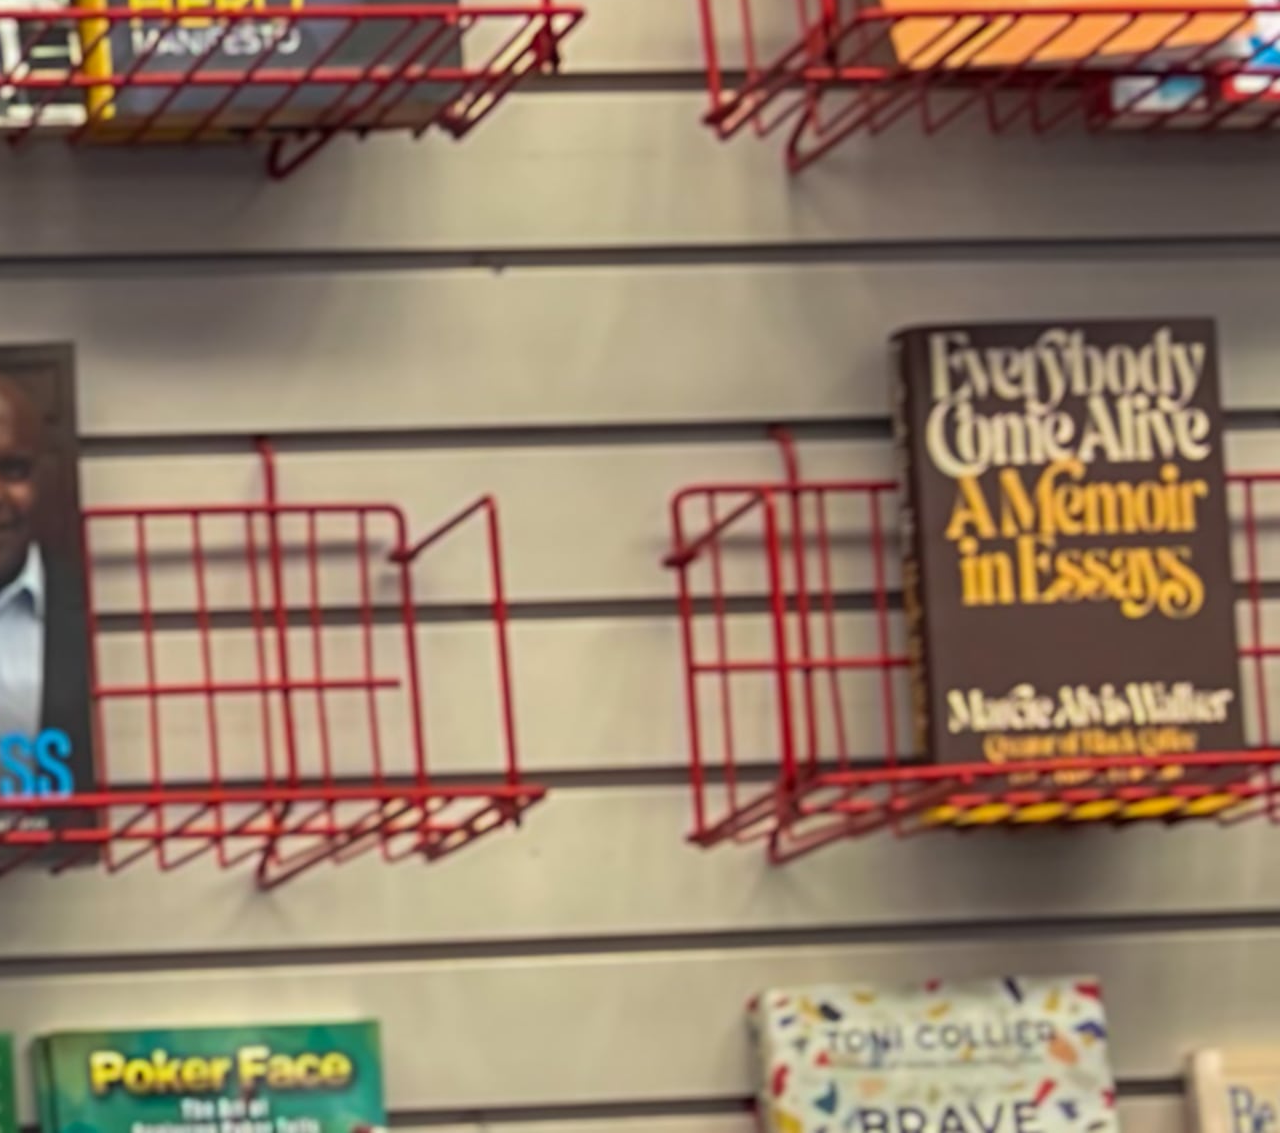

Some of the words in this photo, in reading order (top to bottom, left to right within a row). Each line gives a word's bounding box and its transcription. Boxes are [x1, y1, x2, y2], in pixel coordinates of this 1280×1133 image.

[928, 326, 1206, 412] Everybody
[925, 398, 1076, 478] Come
[1080, 394, 1212, 463] Alive
[945, 467, 997, 540] A
[1000, 457, 1209, 537] Memoir
[957, 536, 1016, 606] in
[1016, 534, 1206, 619] Essays
[826, 1026, 904, 1053] TONI
[915, 1018, 1058, 1051] COLLIER
[88, 1047, 233, 1096] Poker
[237, 1044, 353, 1091] Face
[180, 1097, 215, 1120] The
[248, 1096, 269, 1118] of
[857, 1100, 1042, 1133] BRAVE
